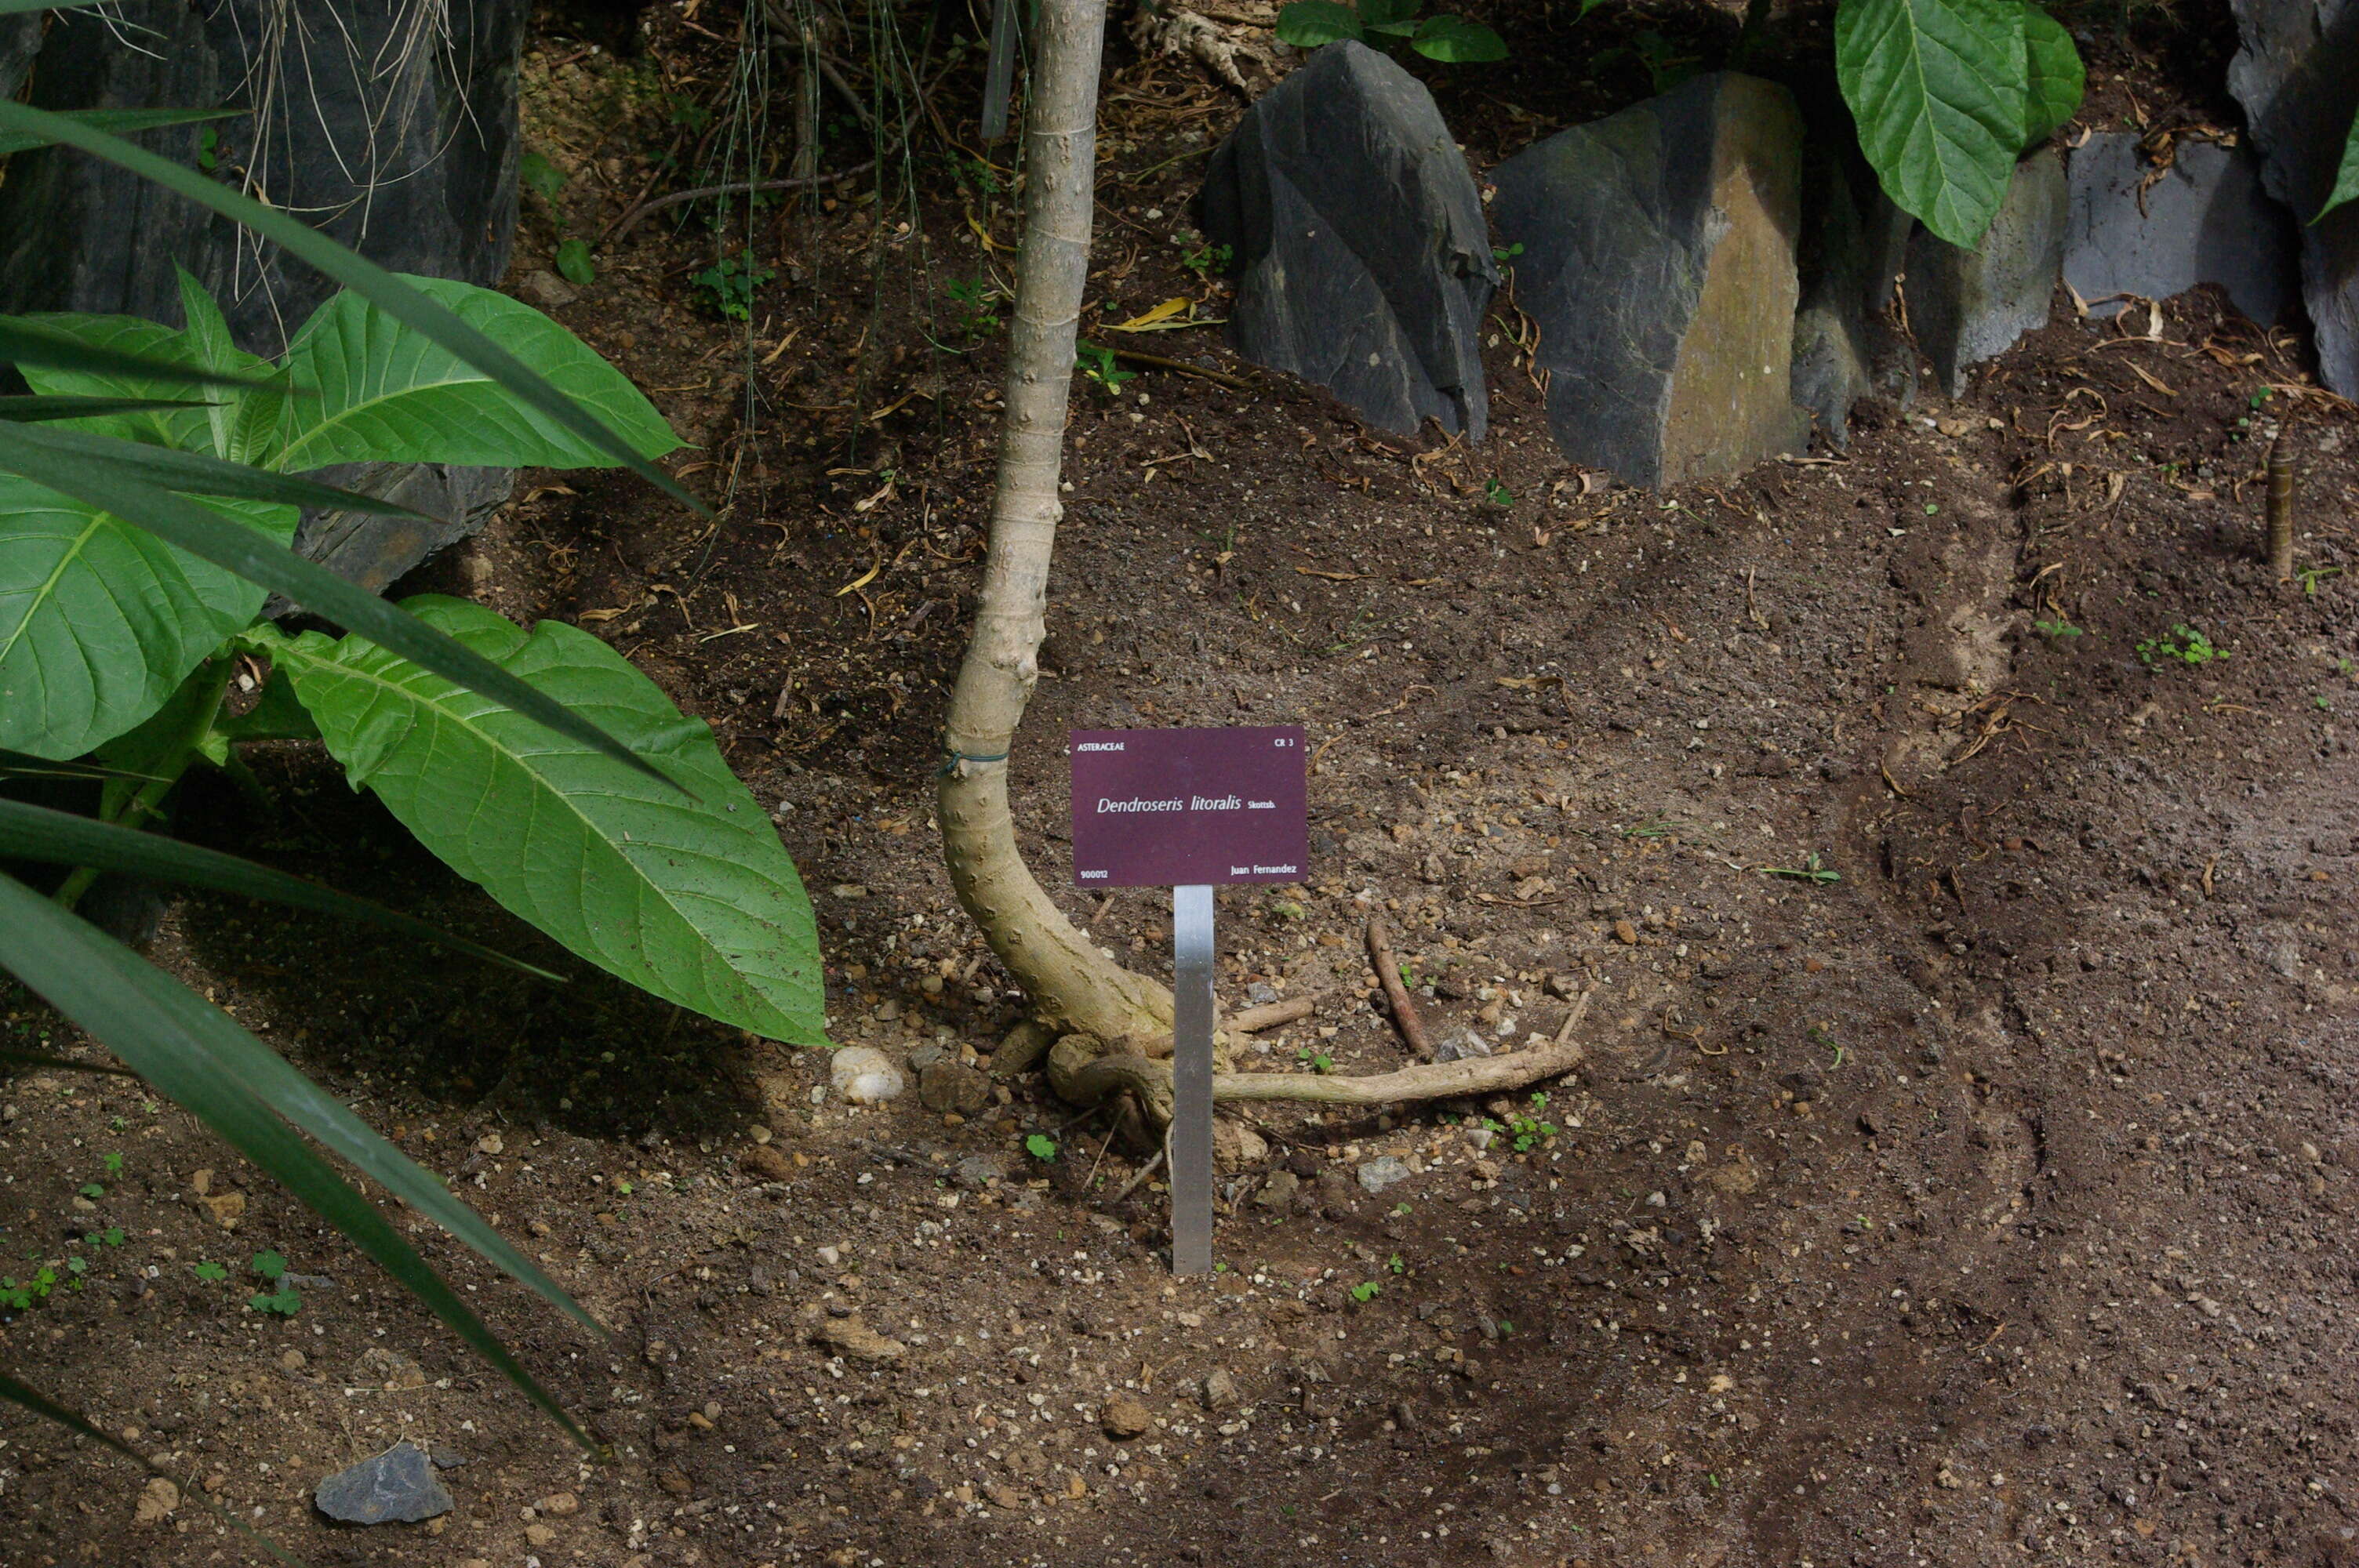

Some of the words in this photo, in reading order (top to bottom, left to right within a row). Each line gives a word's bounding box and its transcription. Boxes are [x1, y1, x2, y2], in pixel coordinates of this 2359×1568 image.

[1078, 742, 1125, 751] ASTERACEAE
[1274, 739, 1285, 747] CR
[1097, 797, 1183, 813] Dendroseris
[1190, 794, 1241, 811] litoralis
[1081, 870, 1108, 879] 900012
[1230, 866, 1249, 876] Juan
[1253, 864, 1297, 874] Fernandez
